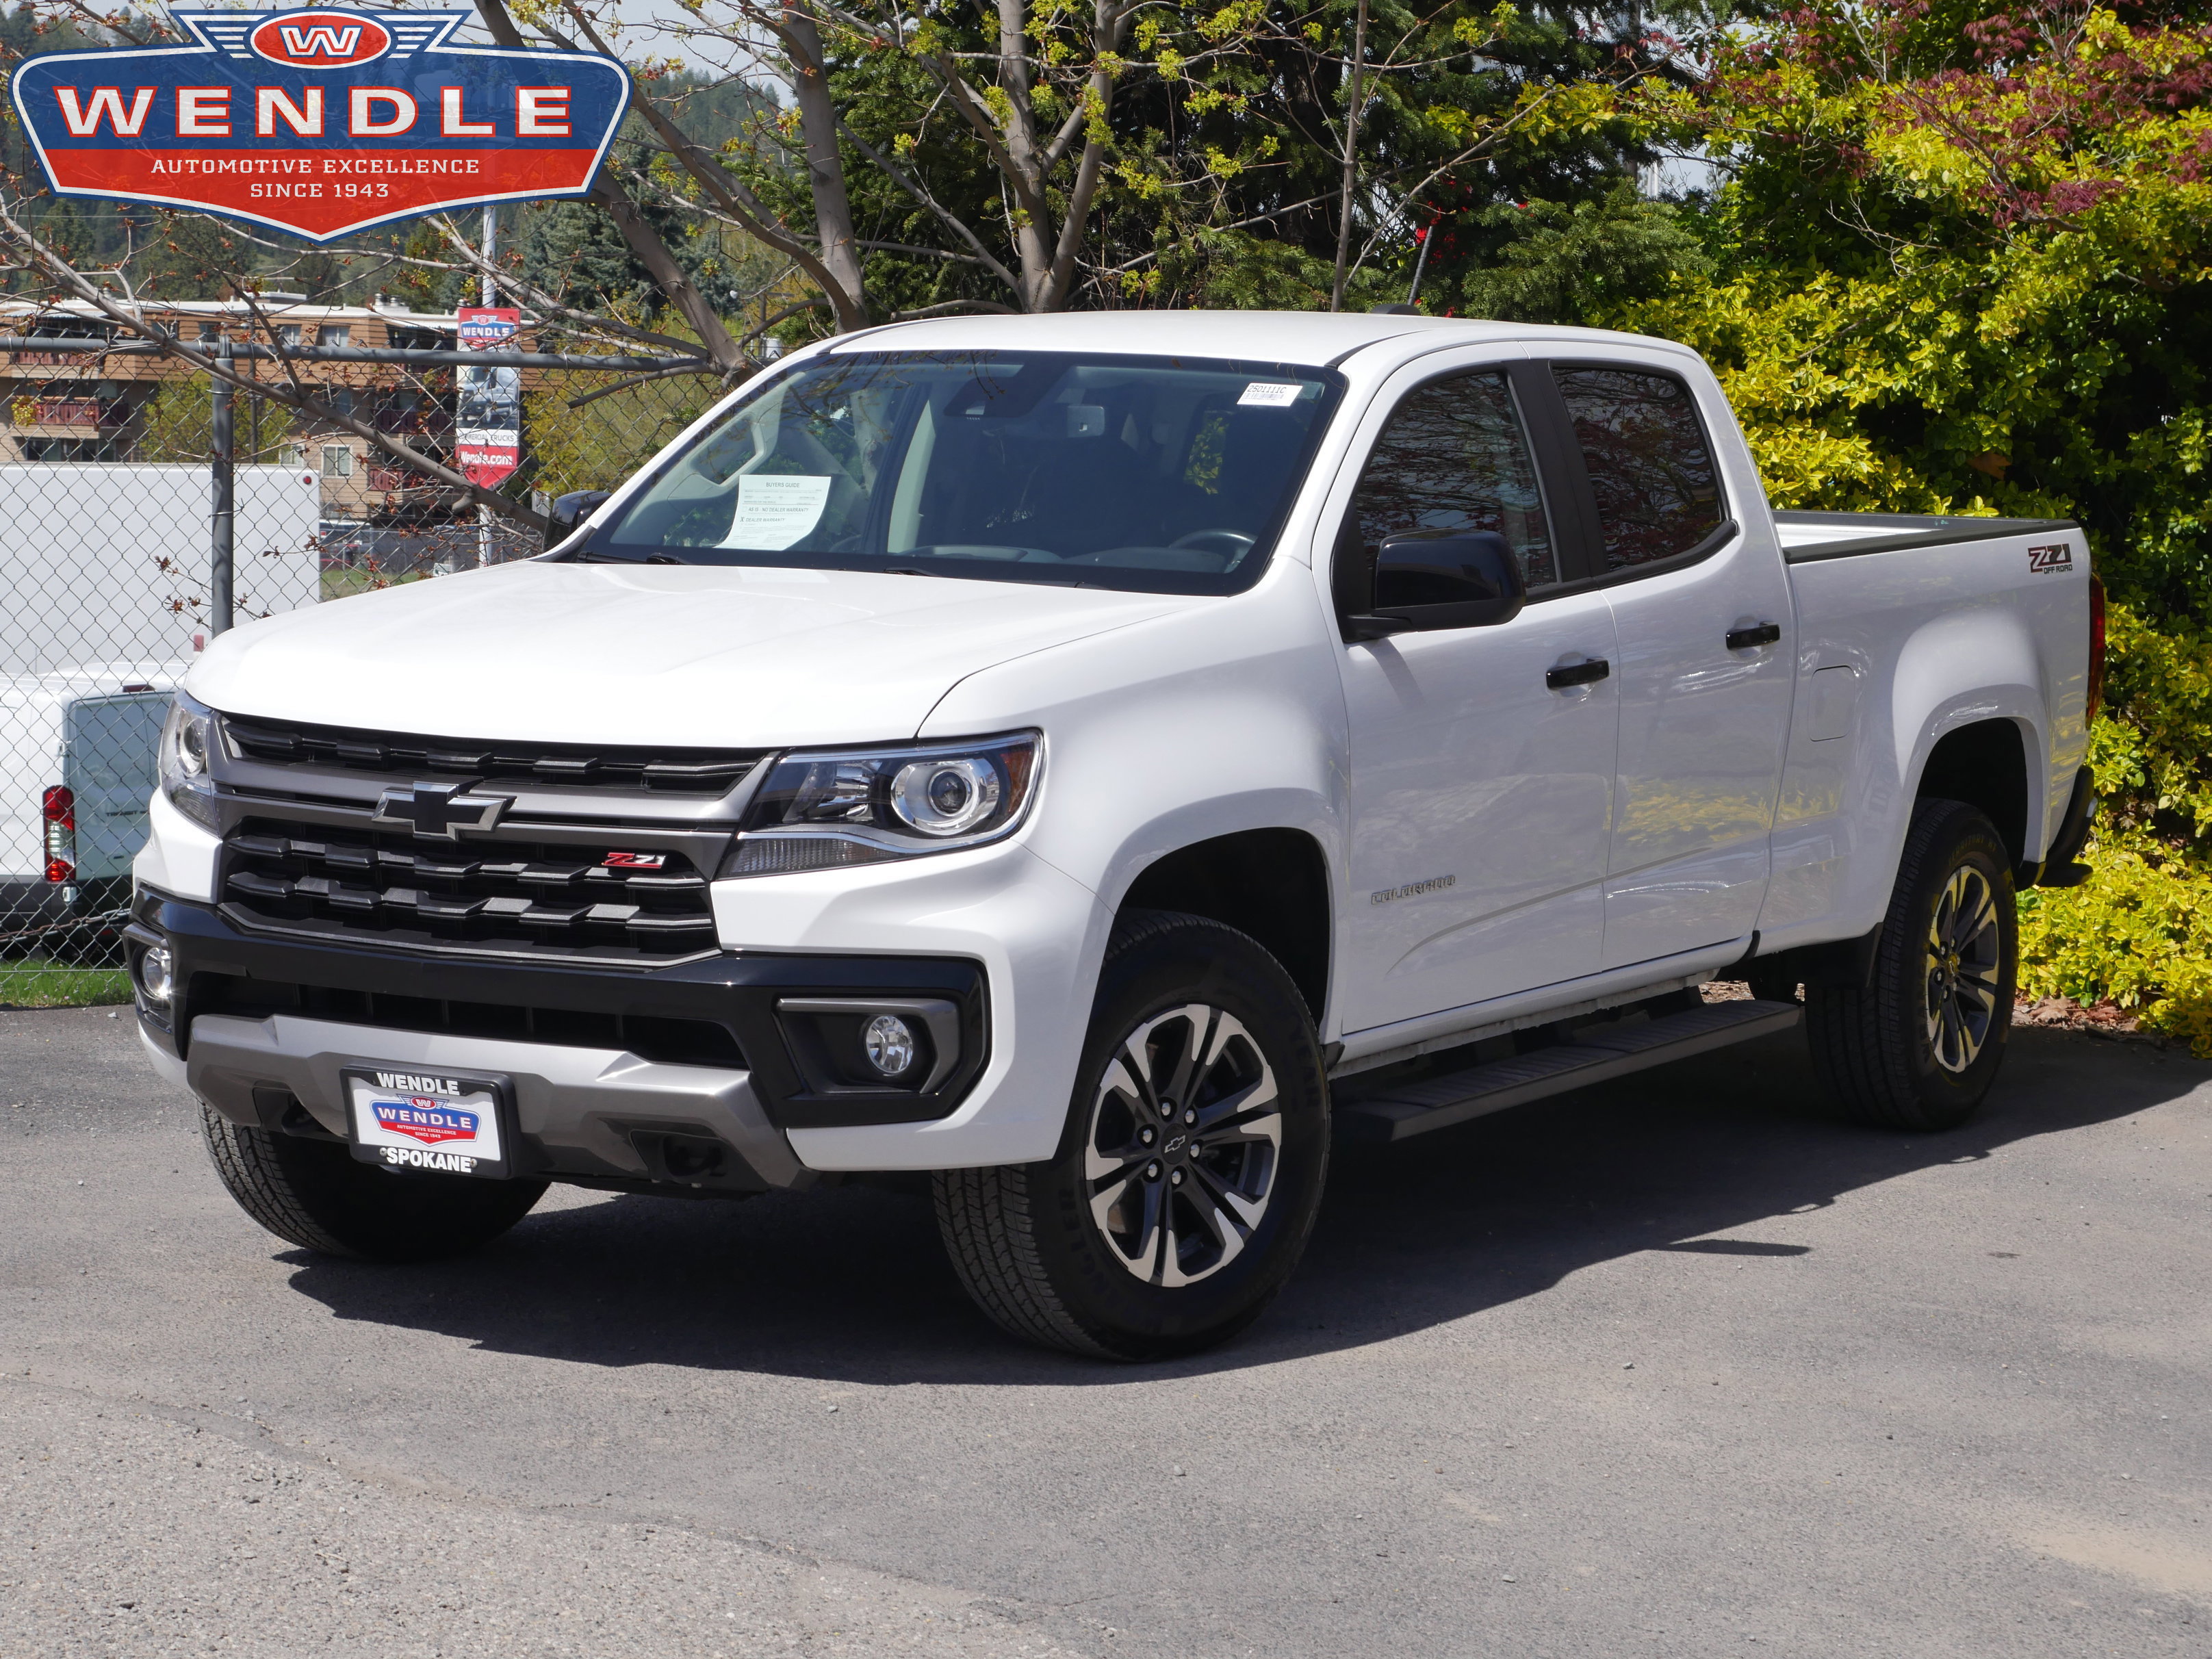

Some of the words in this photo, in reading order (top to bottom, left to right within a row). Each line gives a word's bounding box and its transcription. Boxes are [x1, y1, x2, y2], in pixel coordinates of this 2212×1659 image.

[462, 327, 510, 337] WENDLE
[1247, 385, 1287, 393] 2501111C
[461, 451, 513, 465] Wendle.com
[2027, 543, 2072, 573] Z71
[2044, 566, 2055, 574] OFF
[2056, 564, 2073, 572] ROAD
[603, 852, 666, 869] Z71
[1371, 875, 1456, 905] COLORADO
[376, 1072, 461, 1096] WENDLE
[378, 1107, 472, 1129] WENDLE
[396, 1124, 426, 1132] AUTOMOTIVE
[427, 1127, 457, 1135] EXCELLENCE
[386, 1146, 472, 1173] SPOKANE
